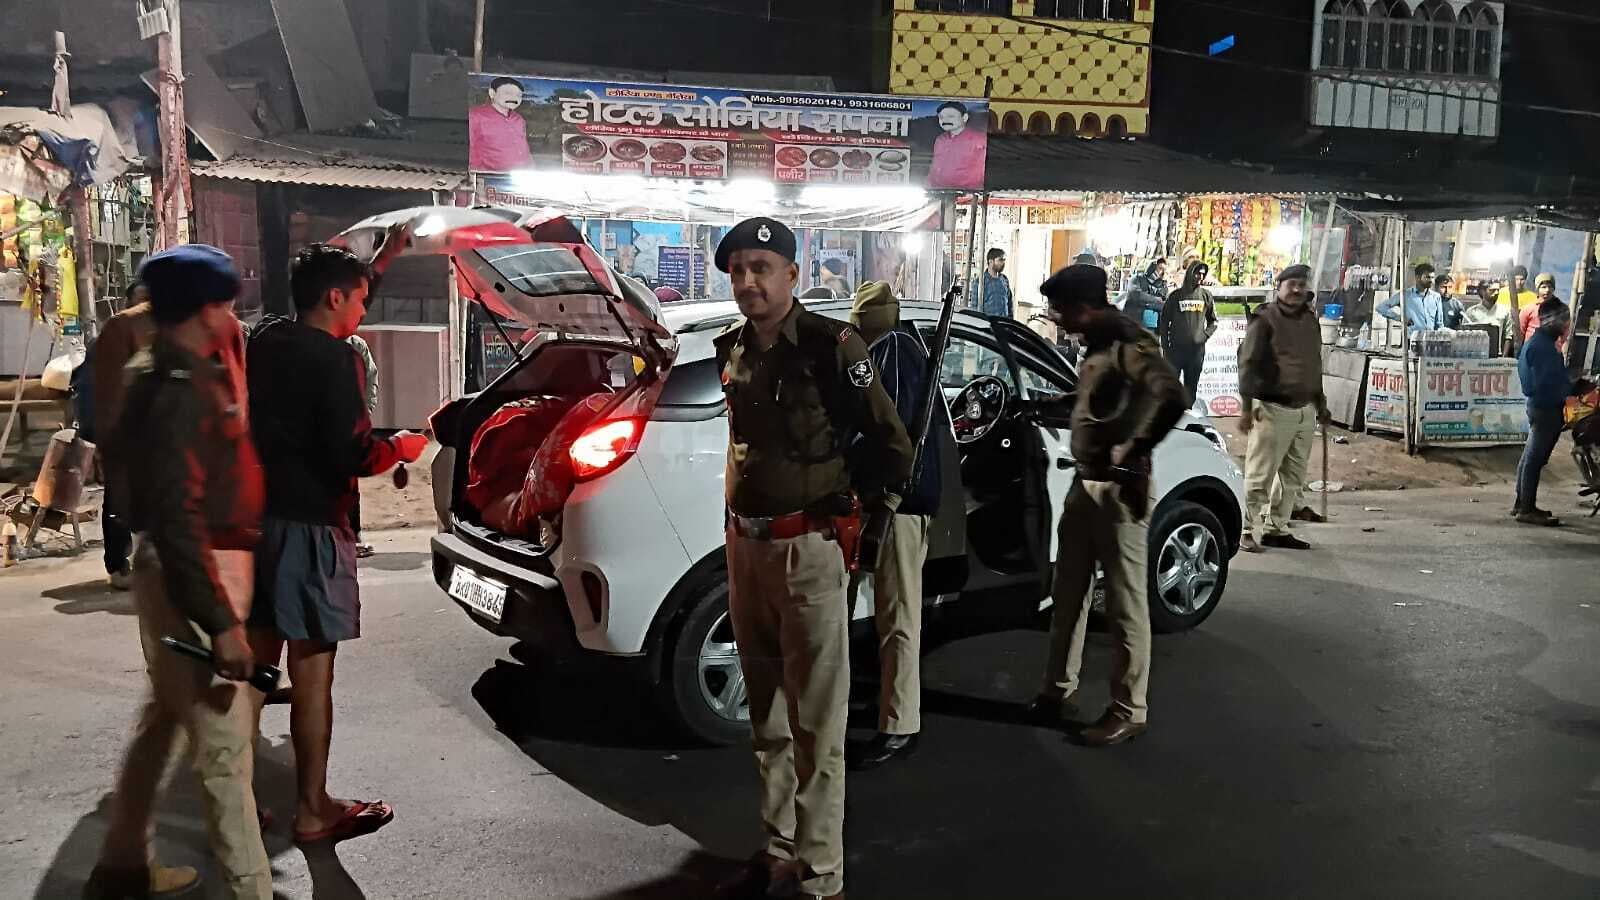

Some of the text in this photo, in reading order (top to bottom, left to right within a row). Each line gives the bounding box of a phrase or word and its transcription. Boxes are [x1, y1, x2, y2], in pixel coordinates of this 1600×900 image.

[559, 89, 912, 137] होटल सोनिया सपना
[1426, 362, 1513, 396] गर्म चाय
